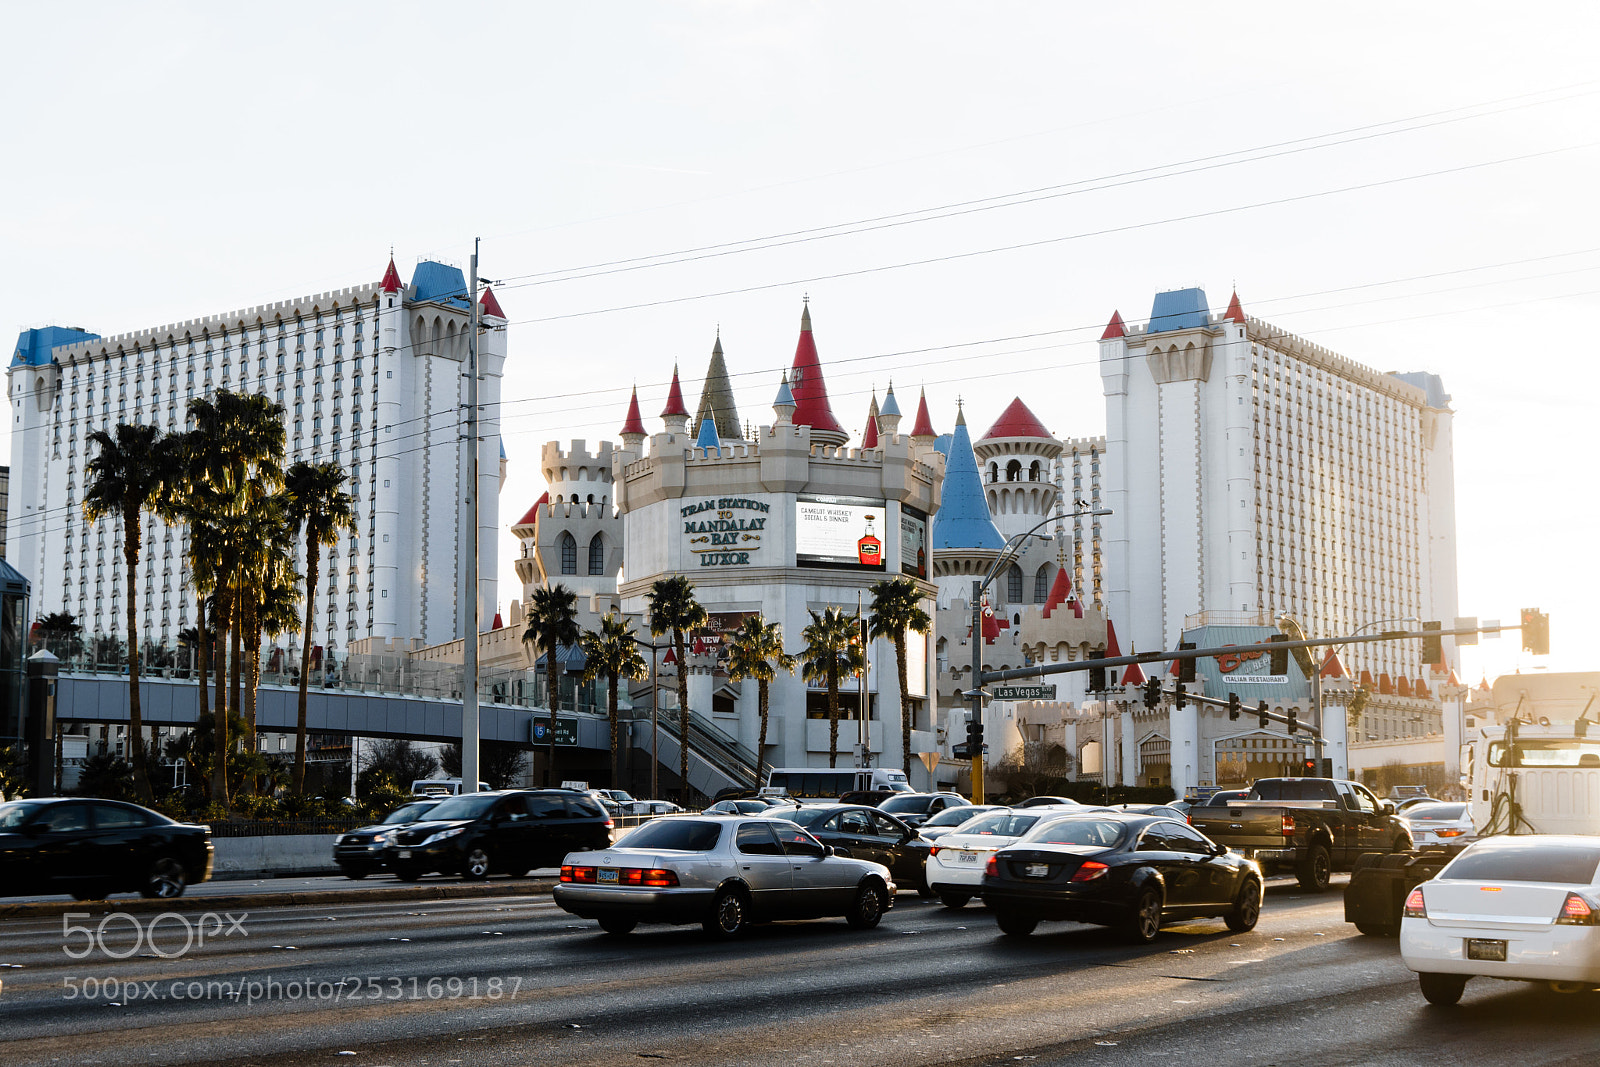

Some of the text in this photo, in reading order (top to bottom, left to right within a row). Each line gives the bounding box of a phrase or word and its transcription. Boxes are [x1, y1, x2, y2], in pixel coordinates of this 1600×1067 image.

[681, 498, 770, 517] TRAM STATION
[801, 507, 852, 517] CAMELOT WHISKEY
[717, 510, 733, 520] TO
[684, 518, 766, 534] MANDALAY
[711, 532, 739, 545] BAY
[701, 552, 750, 566] LUXOR
[701, 636, 720, 644] NEW
[998, 687, 1014, 697] Las
[1015, 687, 1040, 699] Vegas
[537, 727, 543, 736] 15
